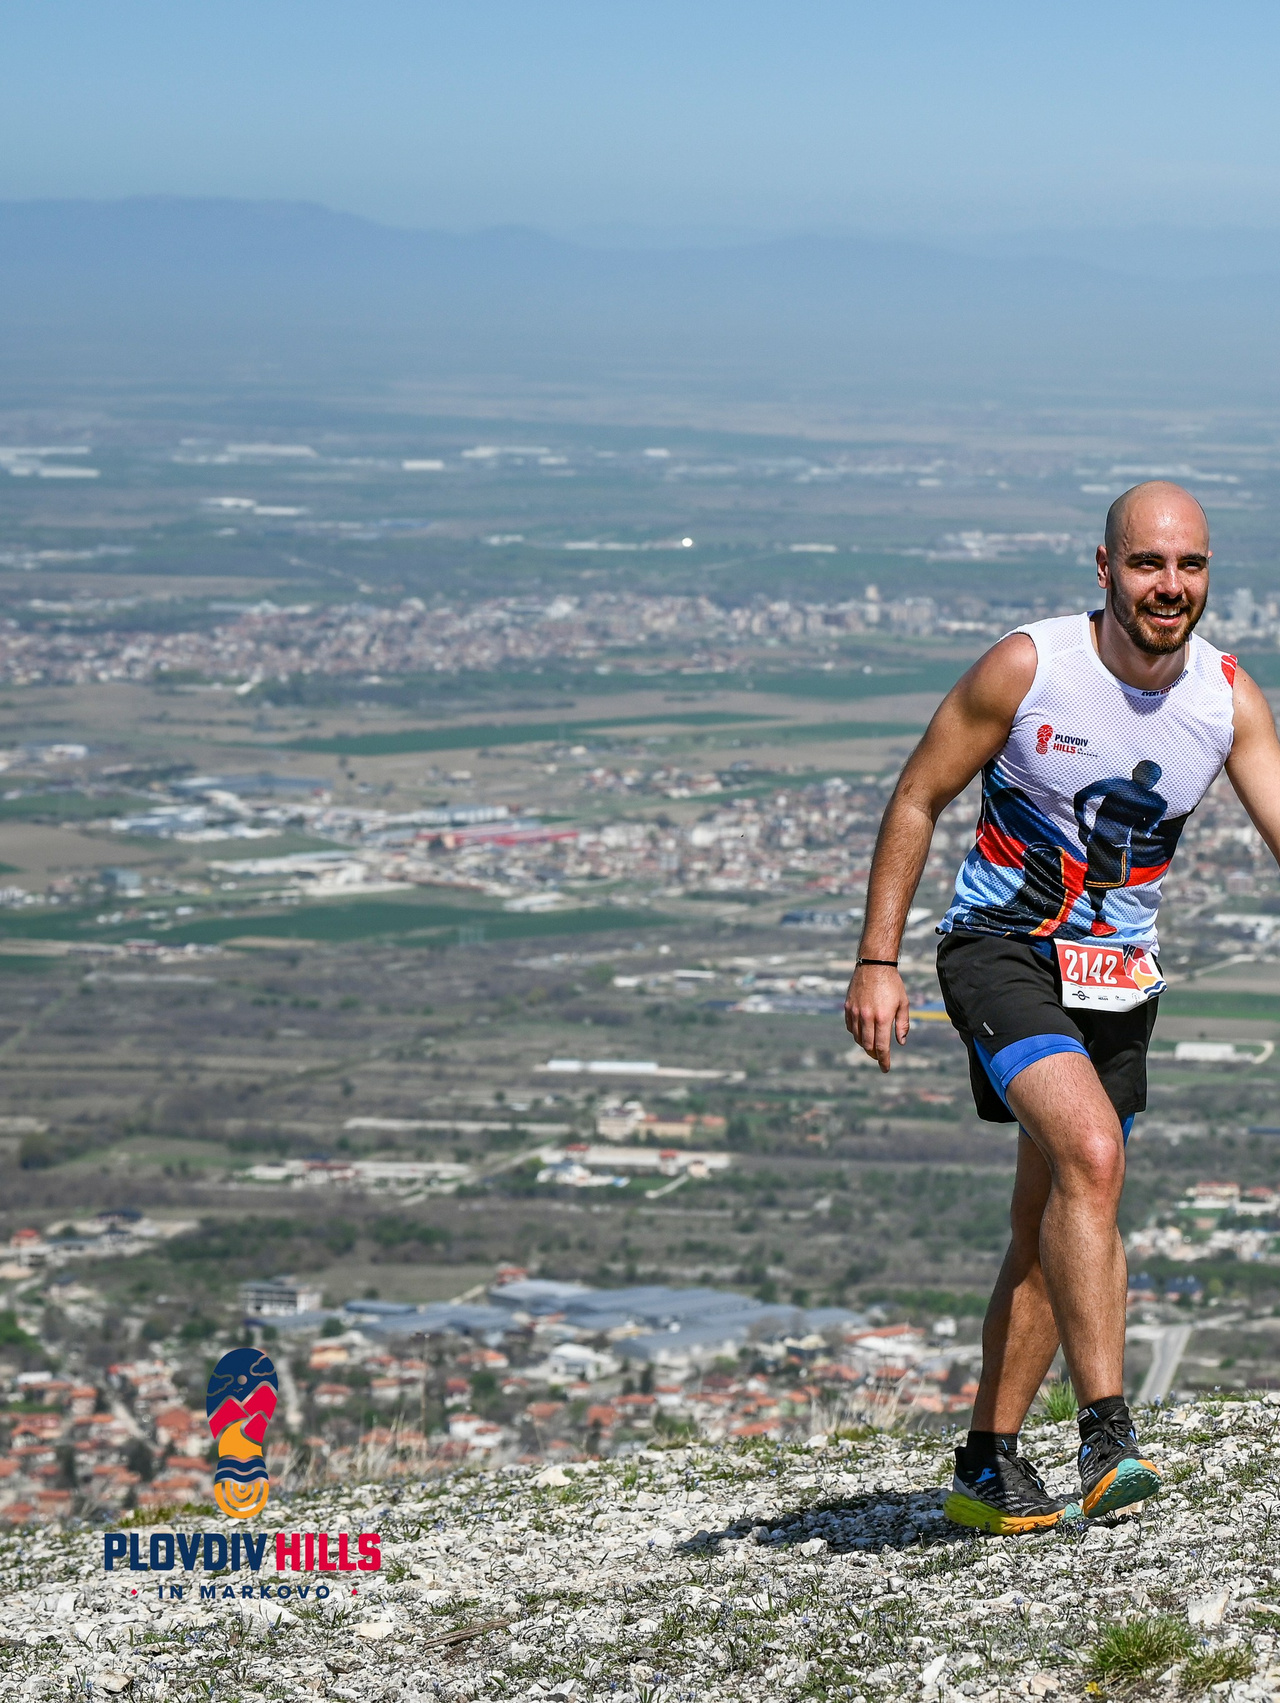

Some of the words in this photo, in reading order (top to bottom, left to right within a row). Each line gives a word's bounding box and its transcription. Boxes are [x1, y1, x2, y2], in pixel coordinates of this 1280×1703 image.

[1054, 733, 1089, 747] PLOVDIV
[1052, 743, 1077, 754] HILLS
[1064, 949, 1118, 985] 2142
